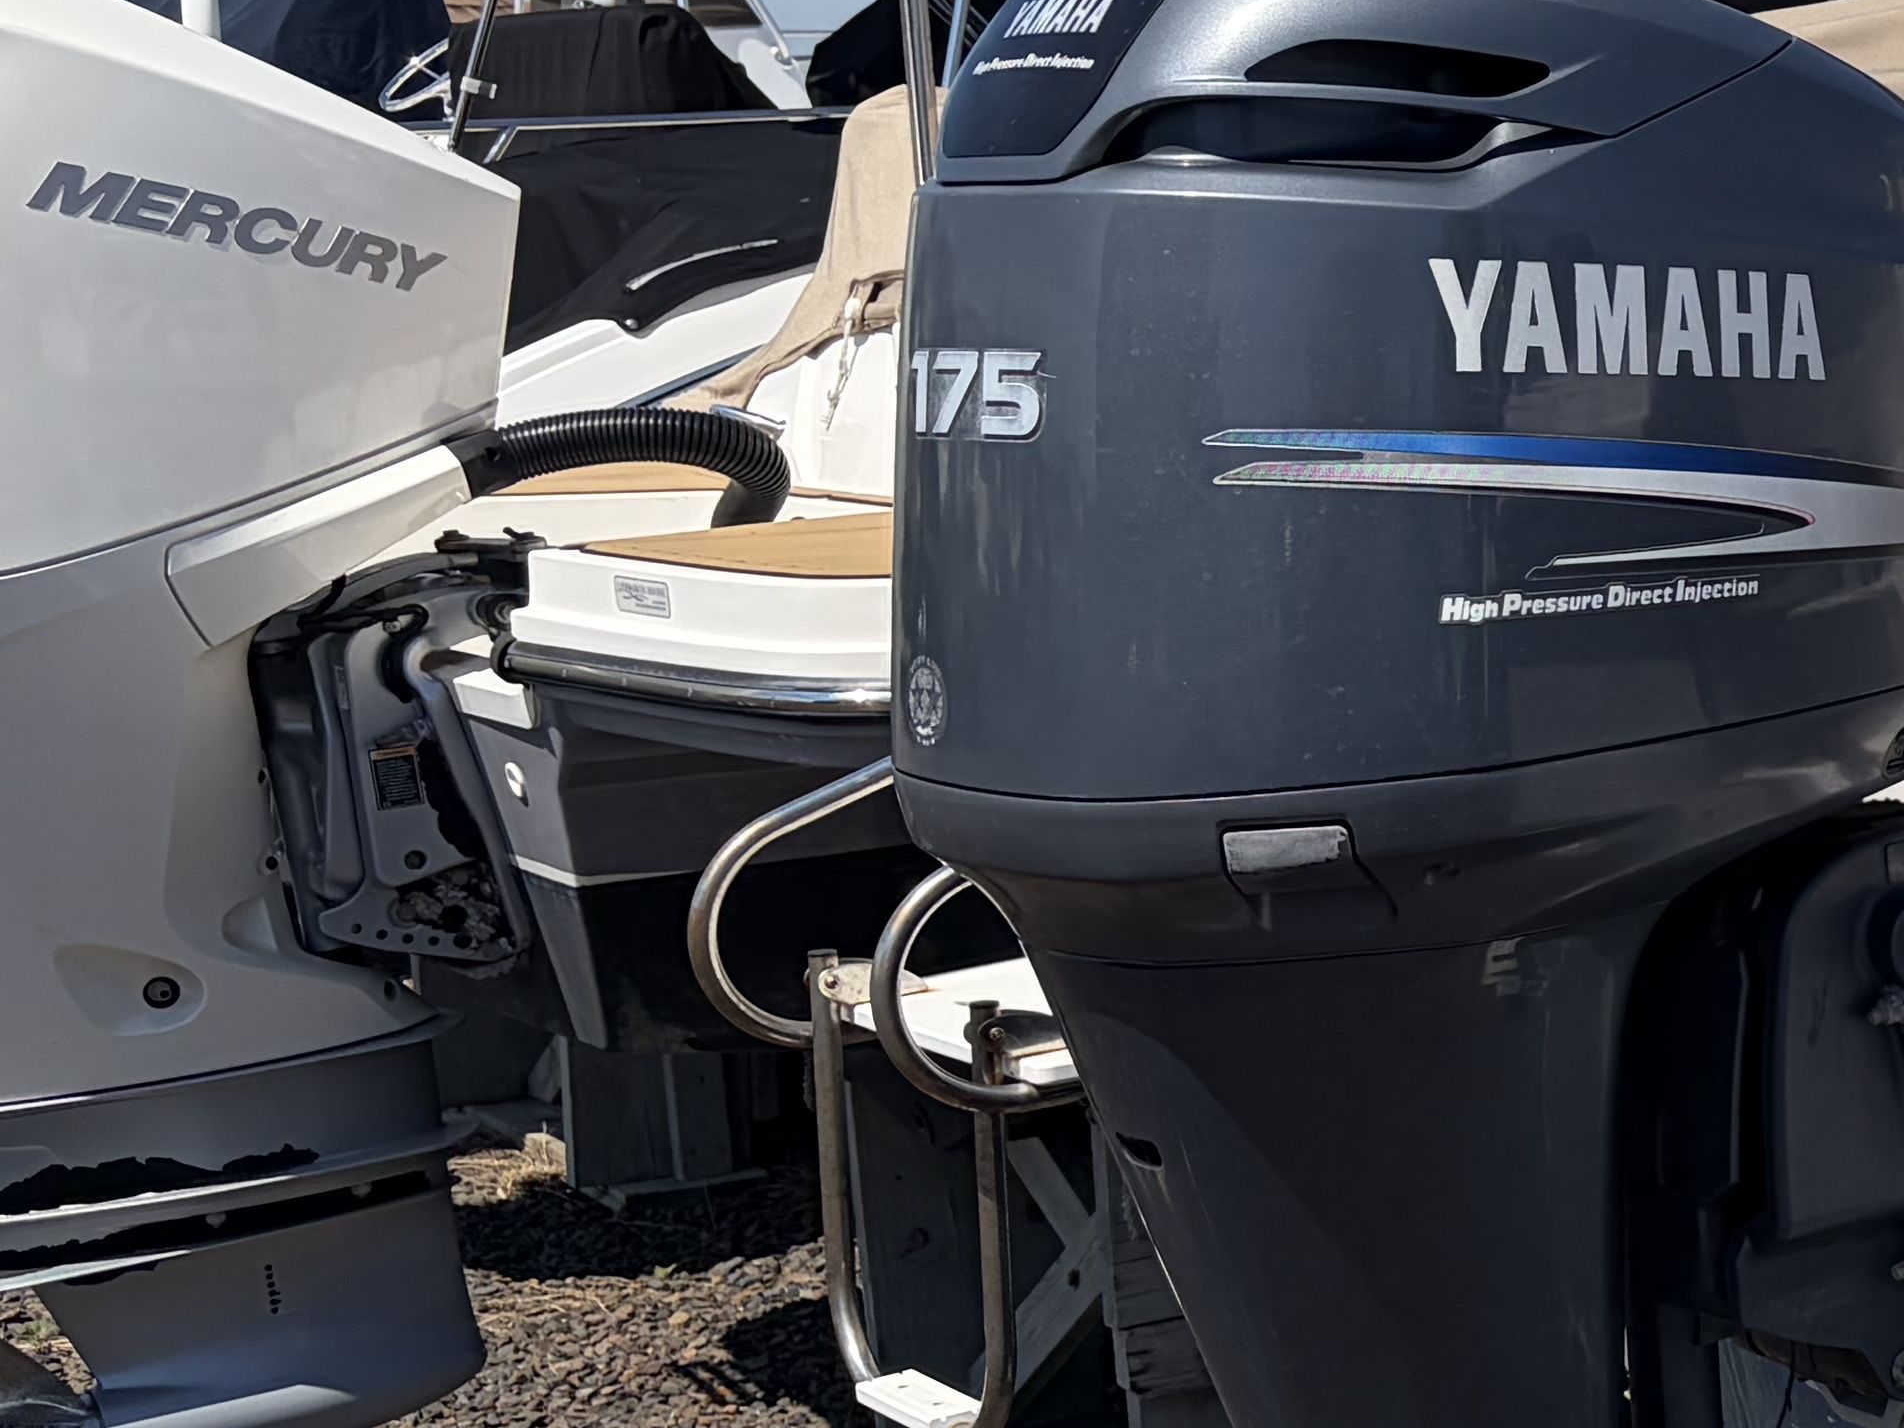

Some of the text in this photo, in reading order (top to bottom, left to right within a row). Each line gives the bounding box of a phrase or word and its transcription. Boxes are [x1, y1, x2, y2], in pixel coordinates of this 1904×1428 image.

[1023, 53, 1053, 68] Direct
[1052, 53, 1095, 69] Injection
[26, 160, 447, 291] MERCURY
[1428, 258, 1826, 380] YAMAHA
[911, 350, 1046, 438] 175
[1441, 579, 1759, 622] High Pressure Direct Injection
